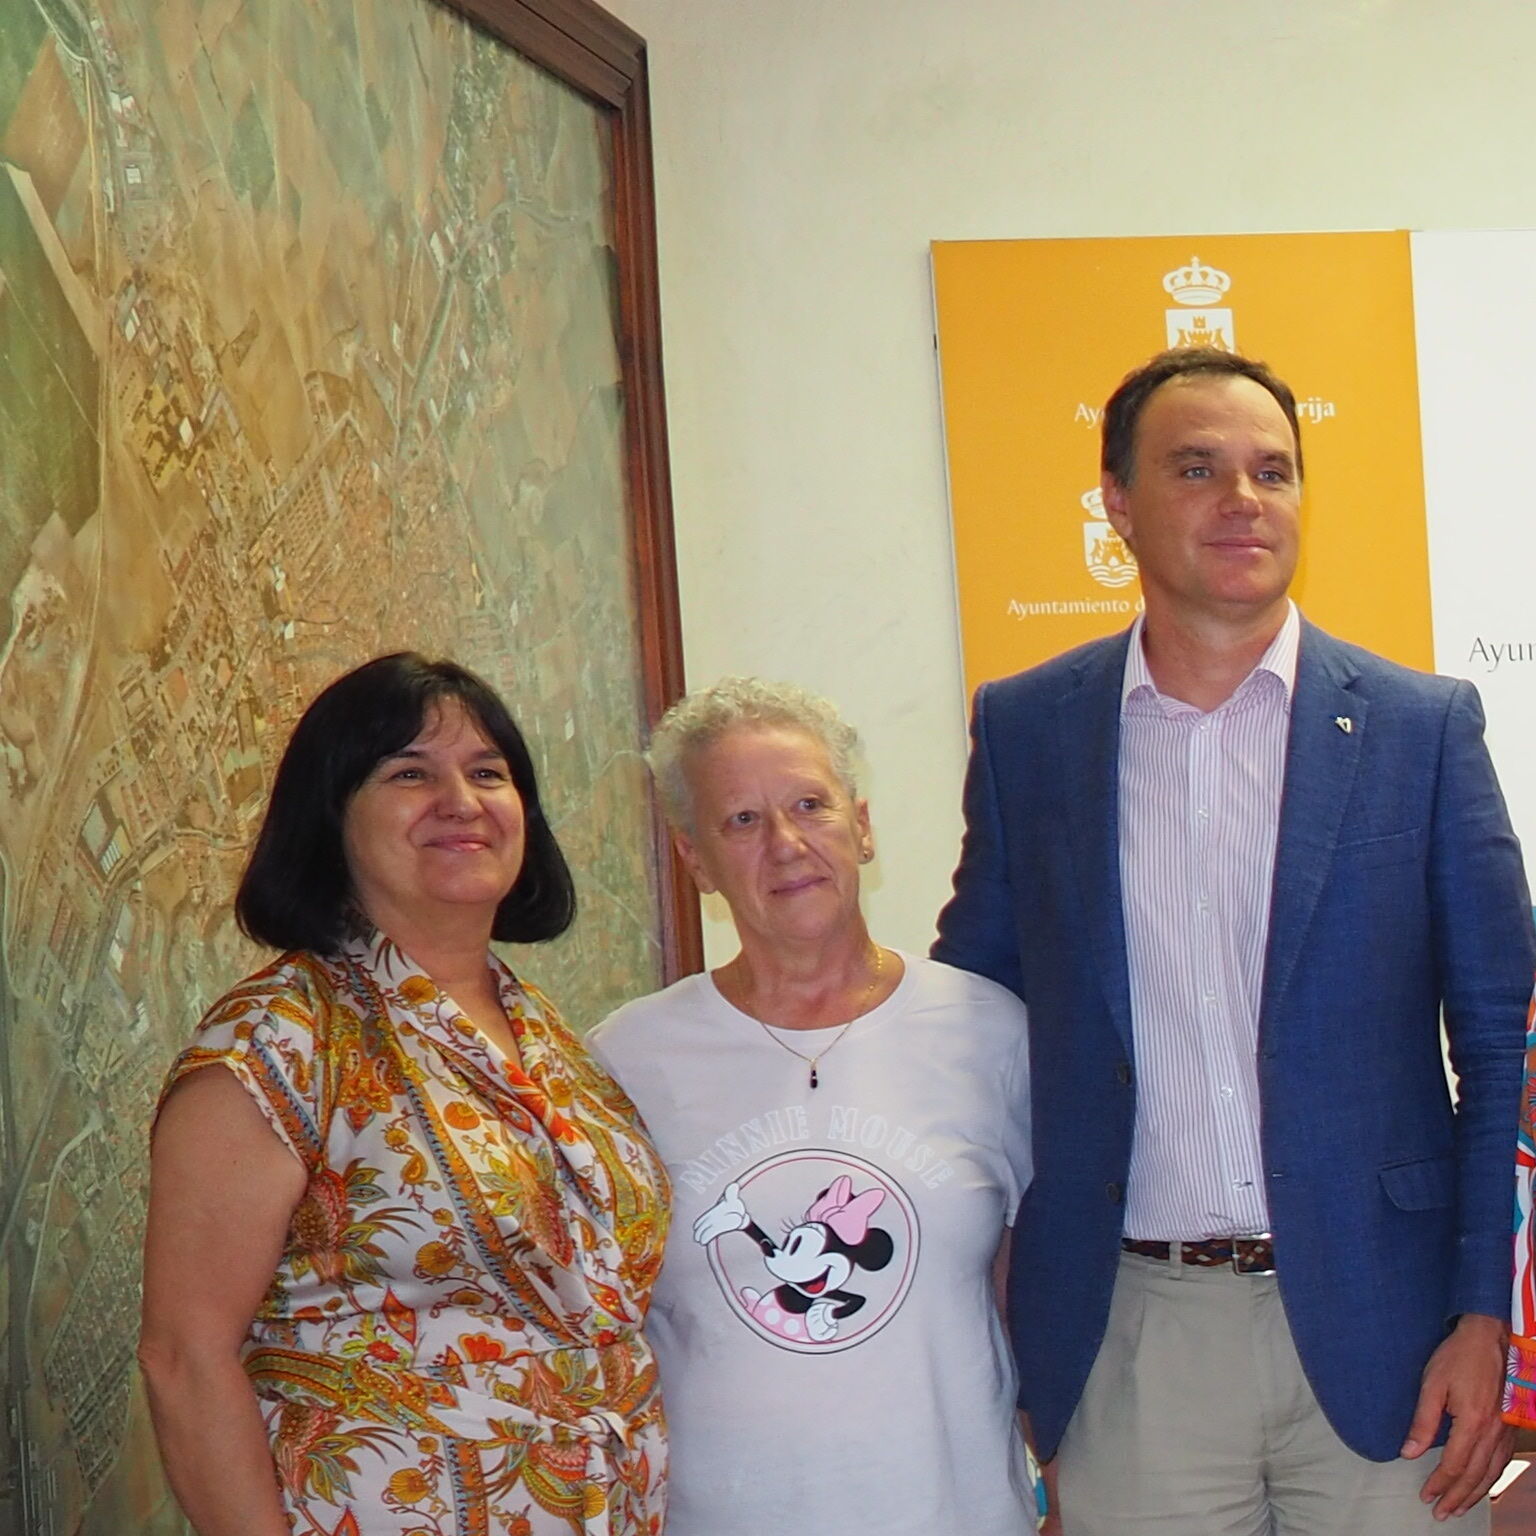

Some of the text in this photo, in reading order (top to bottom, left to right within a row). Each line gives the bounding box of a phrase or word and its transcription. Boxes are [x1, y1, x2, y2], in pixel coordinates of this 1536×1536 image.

[1007, 598, 1130, 620] Ayuntamiento
[679, 1105, 955, 1196] MINNIE MOUSE
